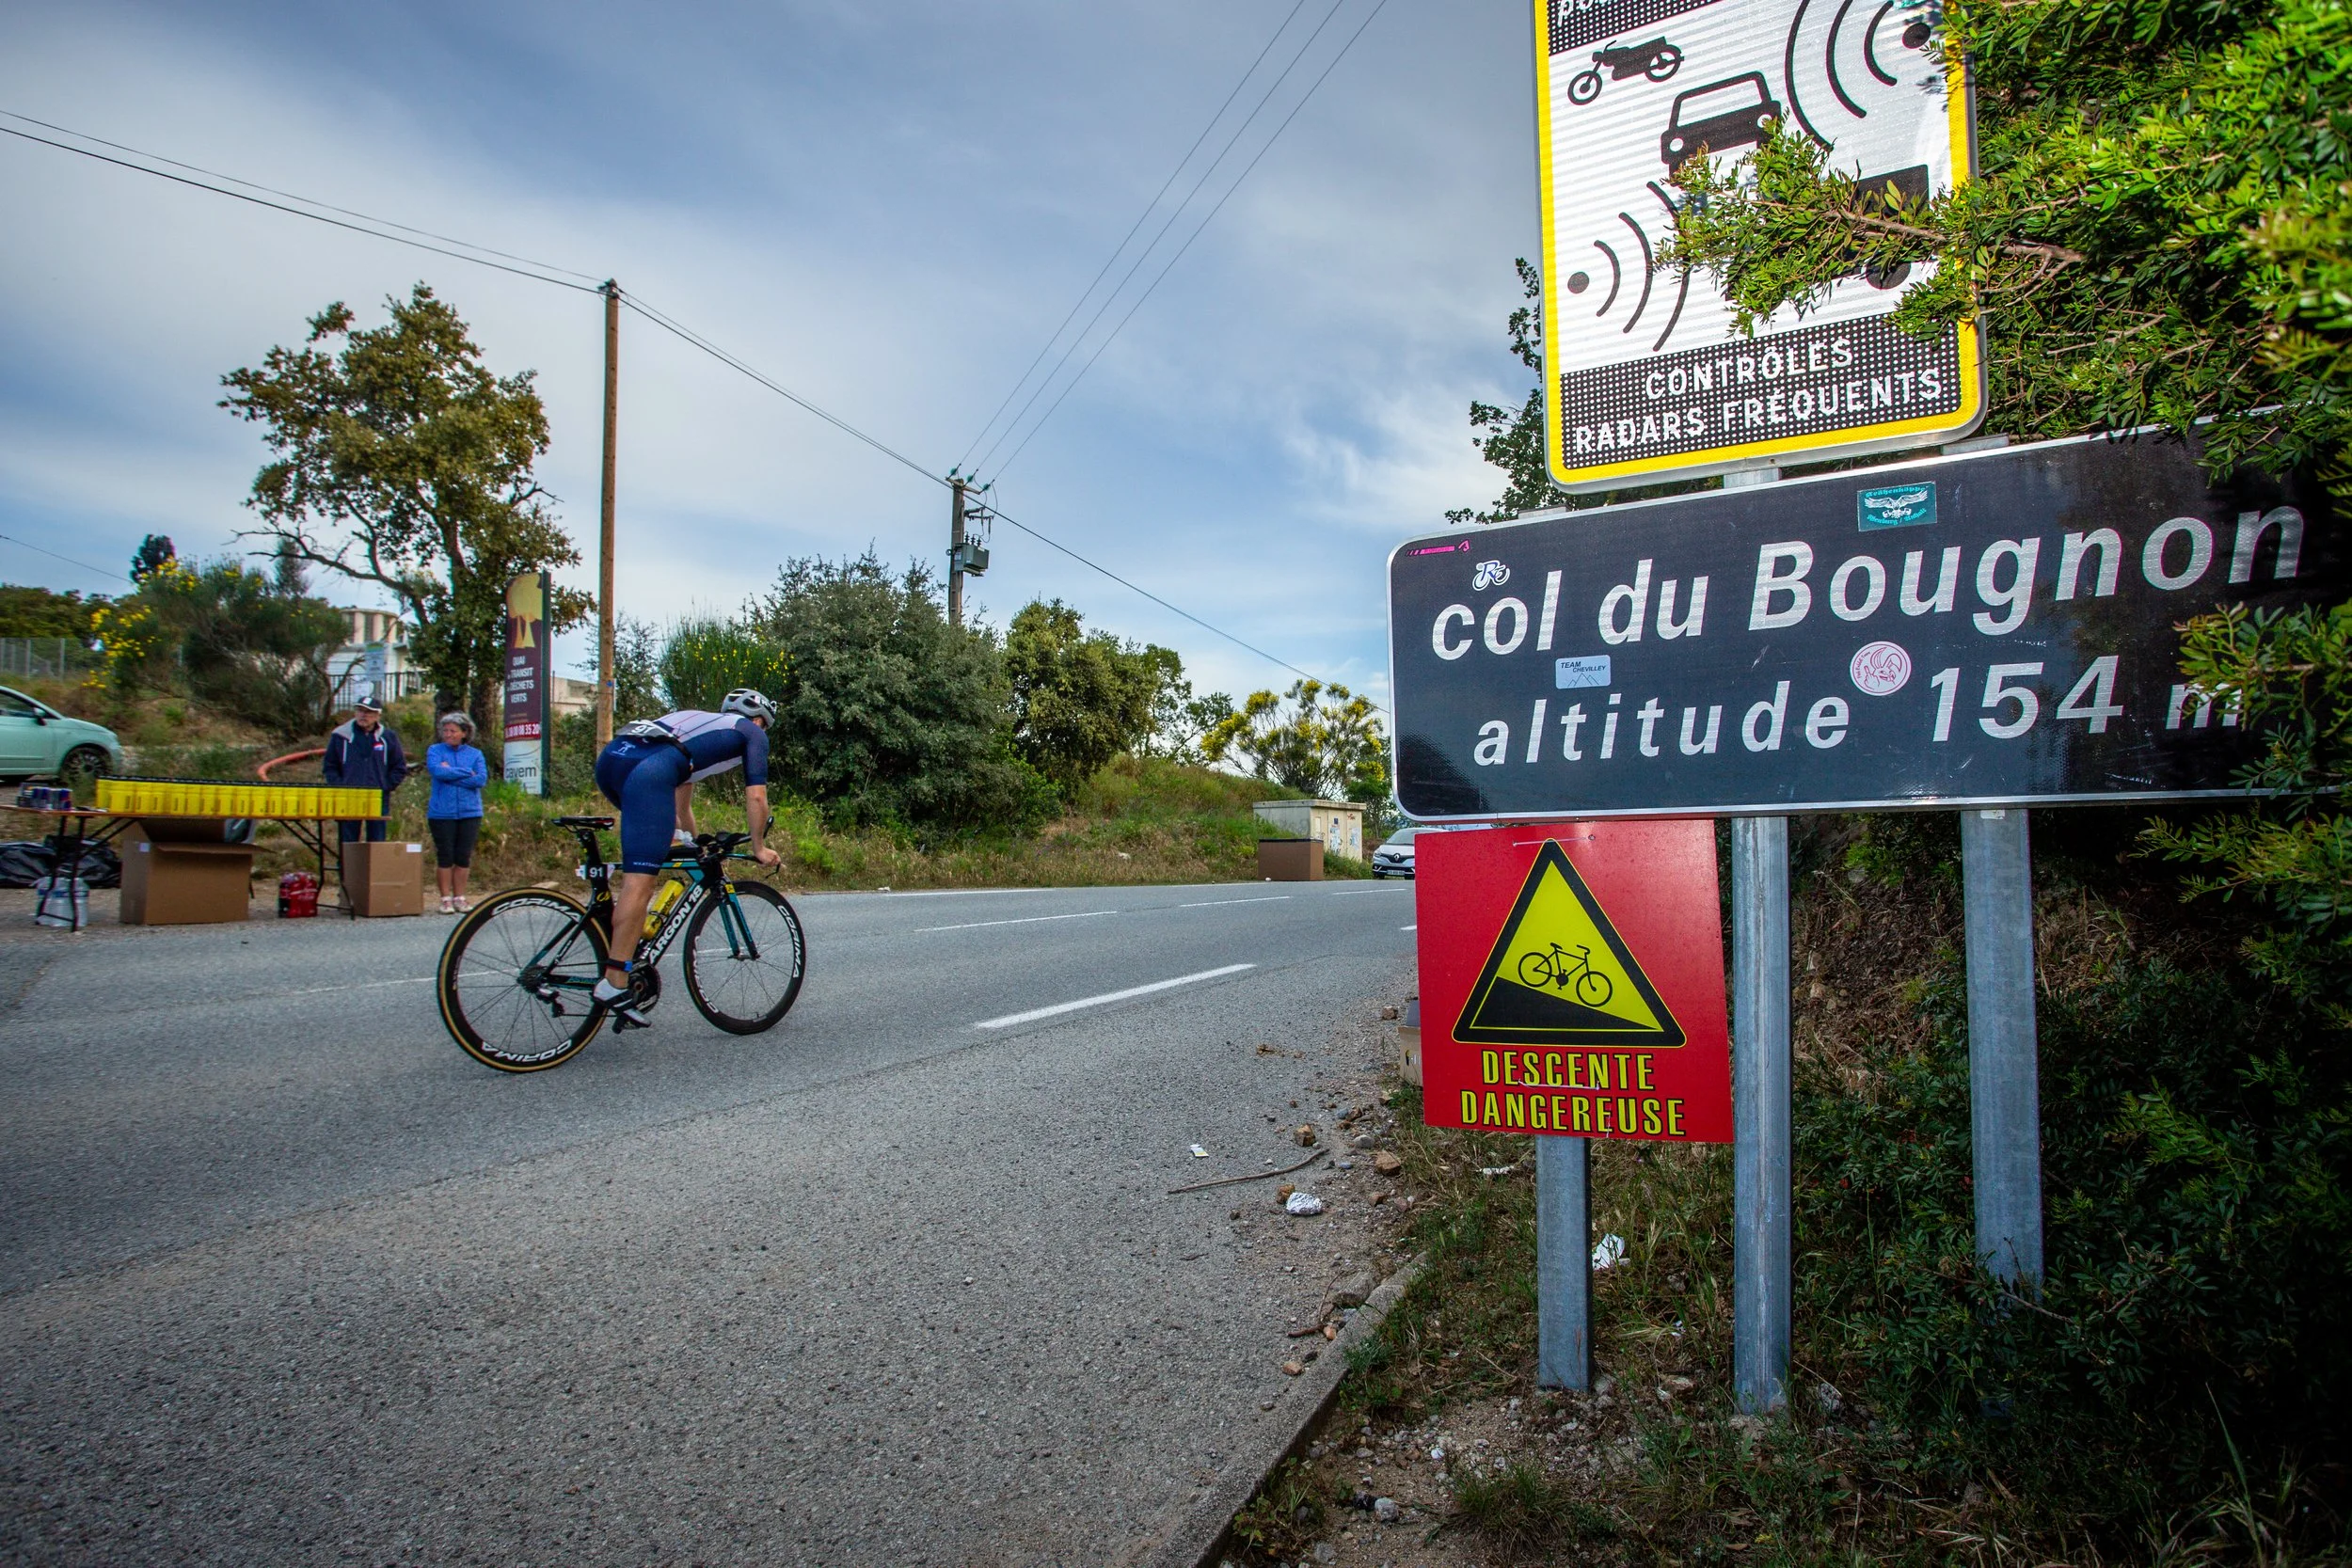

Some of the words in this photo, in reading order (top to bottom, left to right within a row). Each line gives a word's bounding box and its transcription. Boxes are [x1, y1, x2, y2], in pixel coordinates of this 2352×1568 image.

[1645, 338, 1854, 401] CONTRÔLES
[1575, 407, 1706, 454] RADARS
[1723, 368, 1943, 431] FRÉQUENTS
[1432, 569, 1563, 660] col
[1597, 559, 1709, 645] du
[1748, 505, 2305, 636] Bougnon
[510, 667, 533, 677] TRANSIT
[1561, 660, 1581, 669] TEAM
[1572, 665, 1606, 673] CHEVILLEY
[511, 692, 527, 704] VERTS
[1474, 681, 1850, 767] altitude
[1931, 655, 2124, 742] 154
[2165, 682, 2244, 731] m
[631, 724, 655, 735] 91
[505, 767, 536, 779] cavem
[589, 867, 603, 878] 91
[491, 897, 582, 924] CORIMA
[649, 901, 691, 964] ARGON
[689, 885, 705, 903] 18
[777, 905, 802, 978] CORIMA
[482, 1038, 573, 1062] CORIMA
[1482, 1050, 1656, 1090] DESCENTE
[1461, 1089, 1686, 1136] DANGEREUSE
